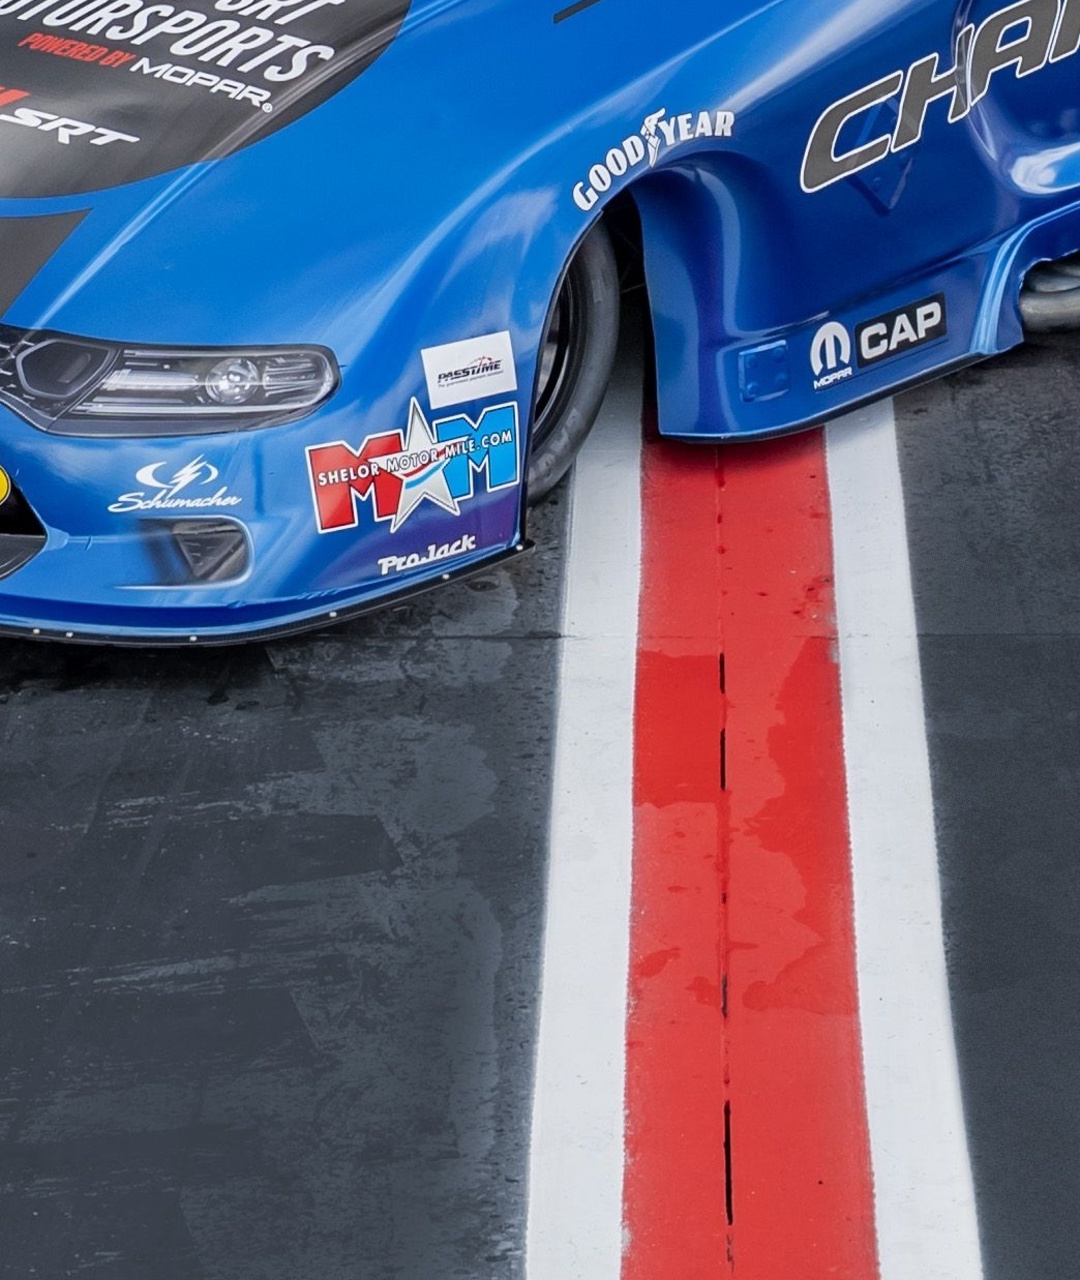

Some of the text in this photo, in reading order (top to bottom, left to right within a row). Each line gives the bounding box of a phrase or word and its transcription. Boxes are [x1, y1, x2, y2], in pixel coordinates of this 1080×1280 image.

[18, 32, 108, 63] POWERED
[99, 49, 137, 68] BY
[572, 108, 735, 211] GOODYEAR
[860, 301, 942, 360] CAP
[437, 357, 504, 383] PASSTIME
[813, 366, 853, 390] MOPAR
[318, 429, 513, 486] SHELOR MOTOR MILE.COM
[107, 486, 242, 513] Schumacher
